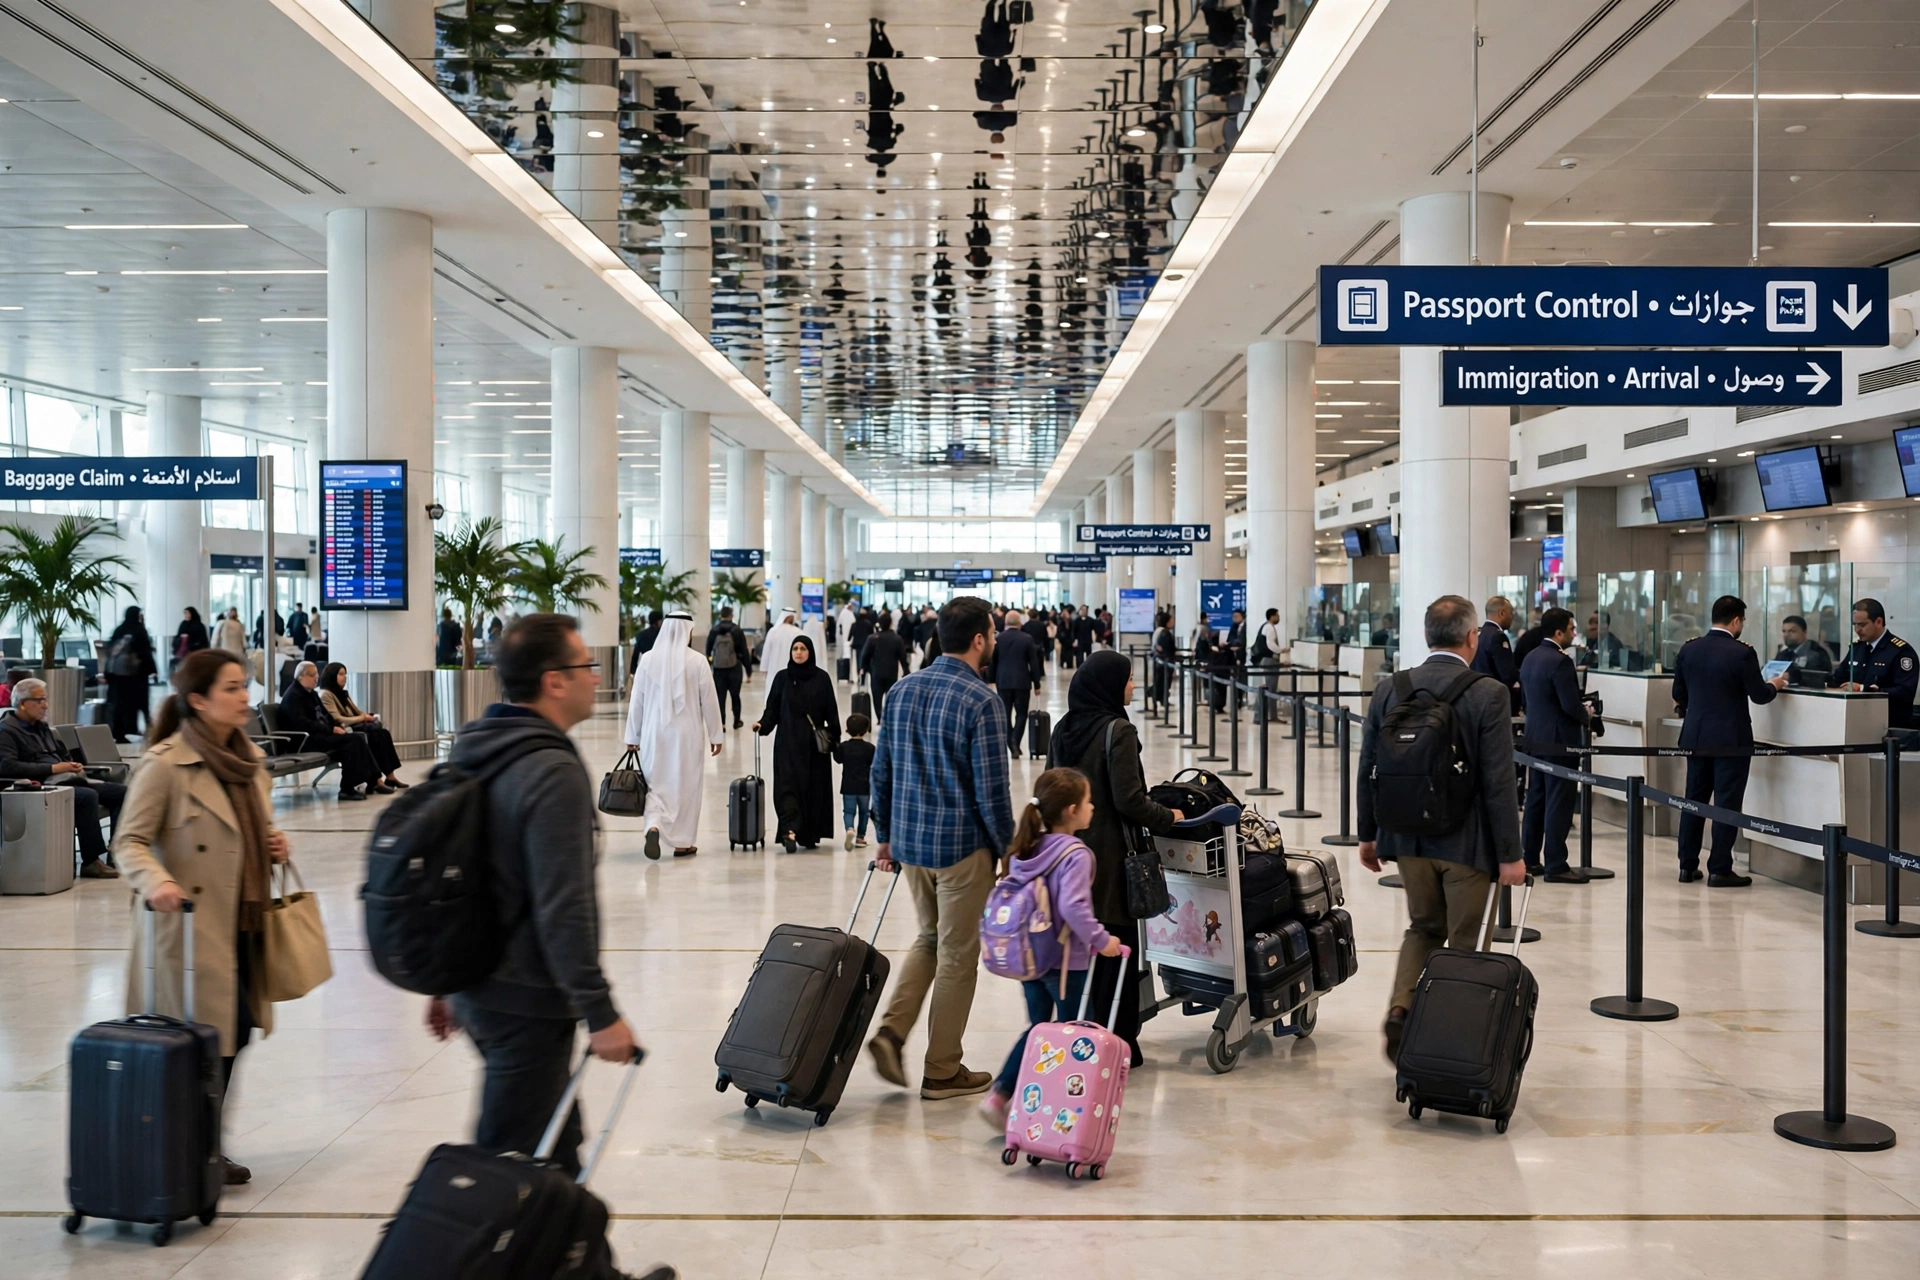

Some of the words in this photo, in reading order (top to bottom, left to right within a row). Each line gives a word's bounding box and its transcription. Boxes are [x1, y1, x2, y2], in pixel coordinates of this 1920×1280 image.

[1404, 290, 1526, 325] Passport
[1535, 289, 1638, 319] Control
[1669, 290, 1756, 324] جوازات
[1458, 366, 1599, 396] Immigration
[1624, 366, 1699, 389] Arrival
[1723, 366, 1785, 393] وصول
[4, 469, 75, 490] Baggage
[79, 468, 124, 486] Claim
[142, 465, 190, 485] الأمتعة
[194, 468, 241, 491] استلام
